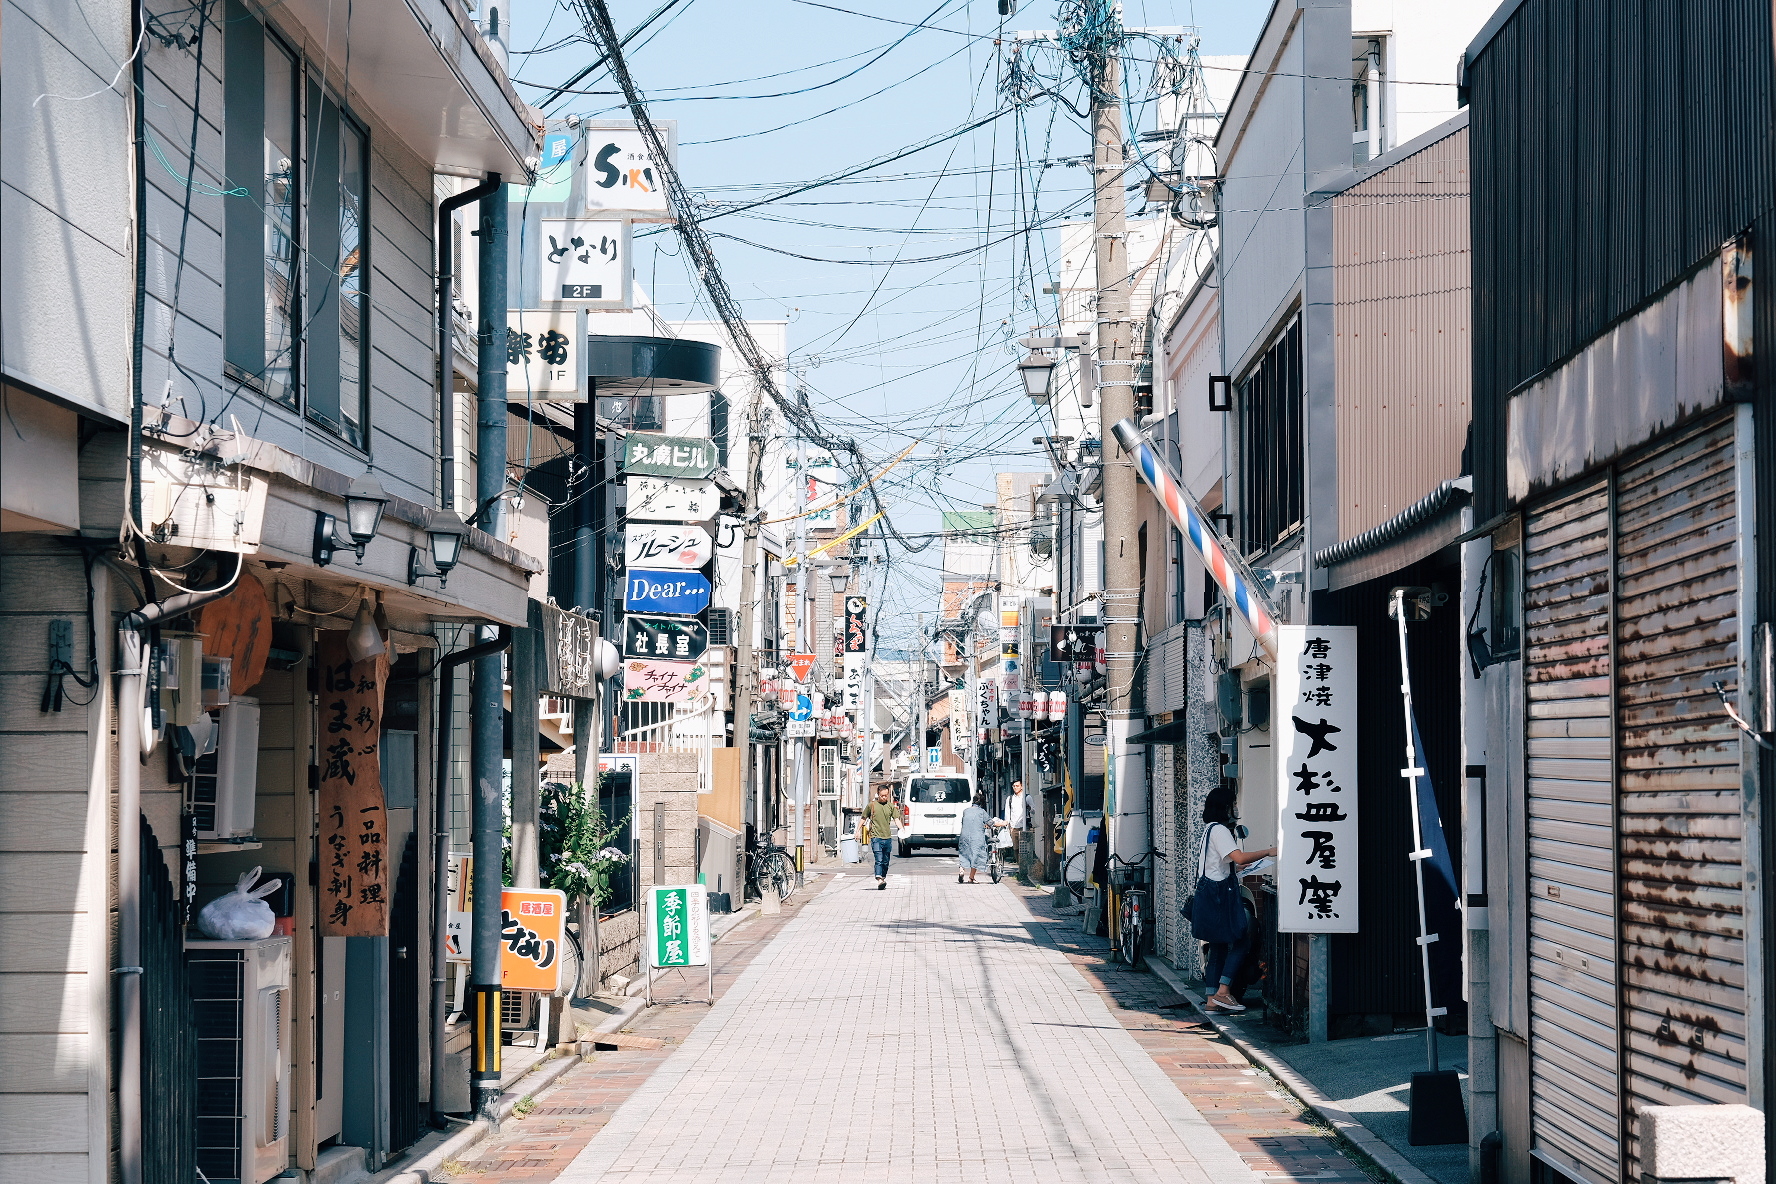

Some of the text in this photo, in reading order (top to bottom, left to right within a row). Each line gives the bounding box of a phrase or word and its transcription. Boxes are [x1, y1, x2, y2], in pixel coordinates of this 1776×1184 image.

[547, 234, 618, 266] となり
[572, 286, 592, 298] 2F
[549, 370, 567, 381] 1F
[631, 529, 657, 543] スナック
[630, 535, 702, 563] ルージュ
[635, 631, 690, 656] 社長室
[792, 658, 812, 667] 止まれ
[1302, 636, 1334, 707] 唐津焼
[643, 669, 679, 691] チャイナ
[655, 682, 689, 699] チャイナ
[321, 658, 356, 787] はま蔵
[326, 804, 354, 927] うなぎ刺身
[356, 805, 386, 905] 一品料理
[520, 902, 553, 916] 居酒屋
[661, 890, 685, 964] 季節屋
